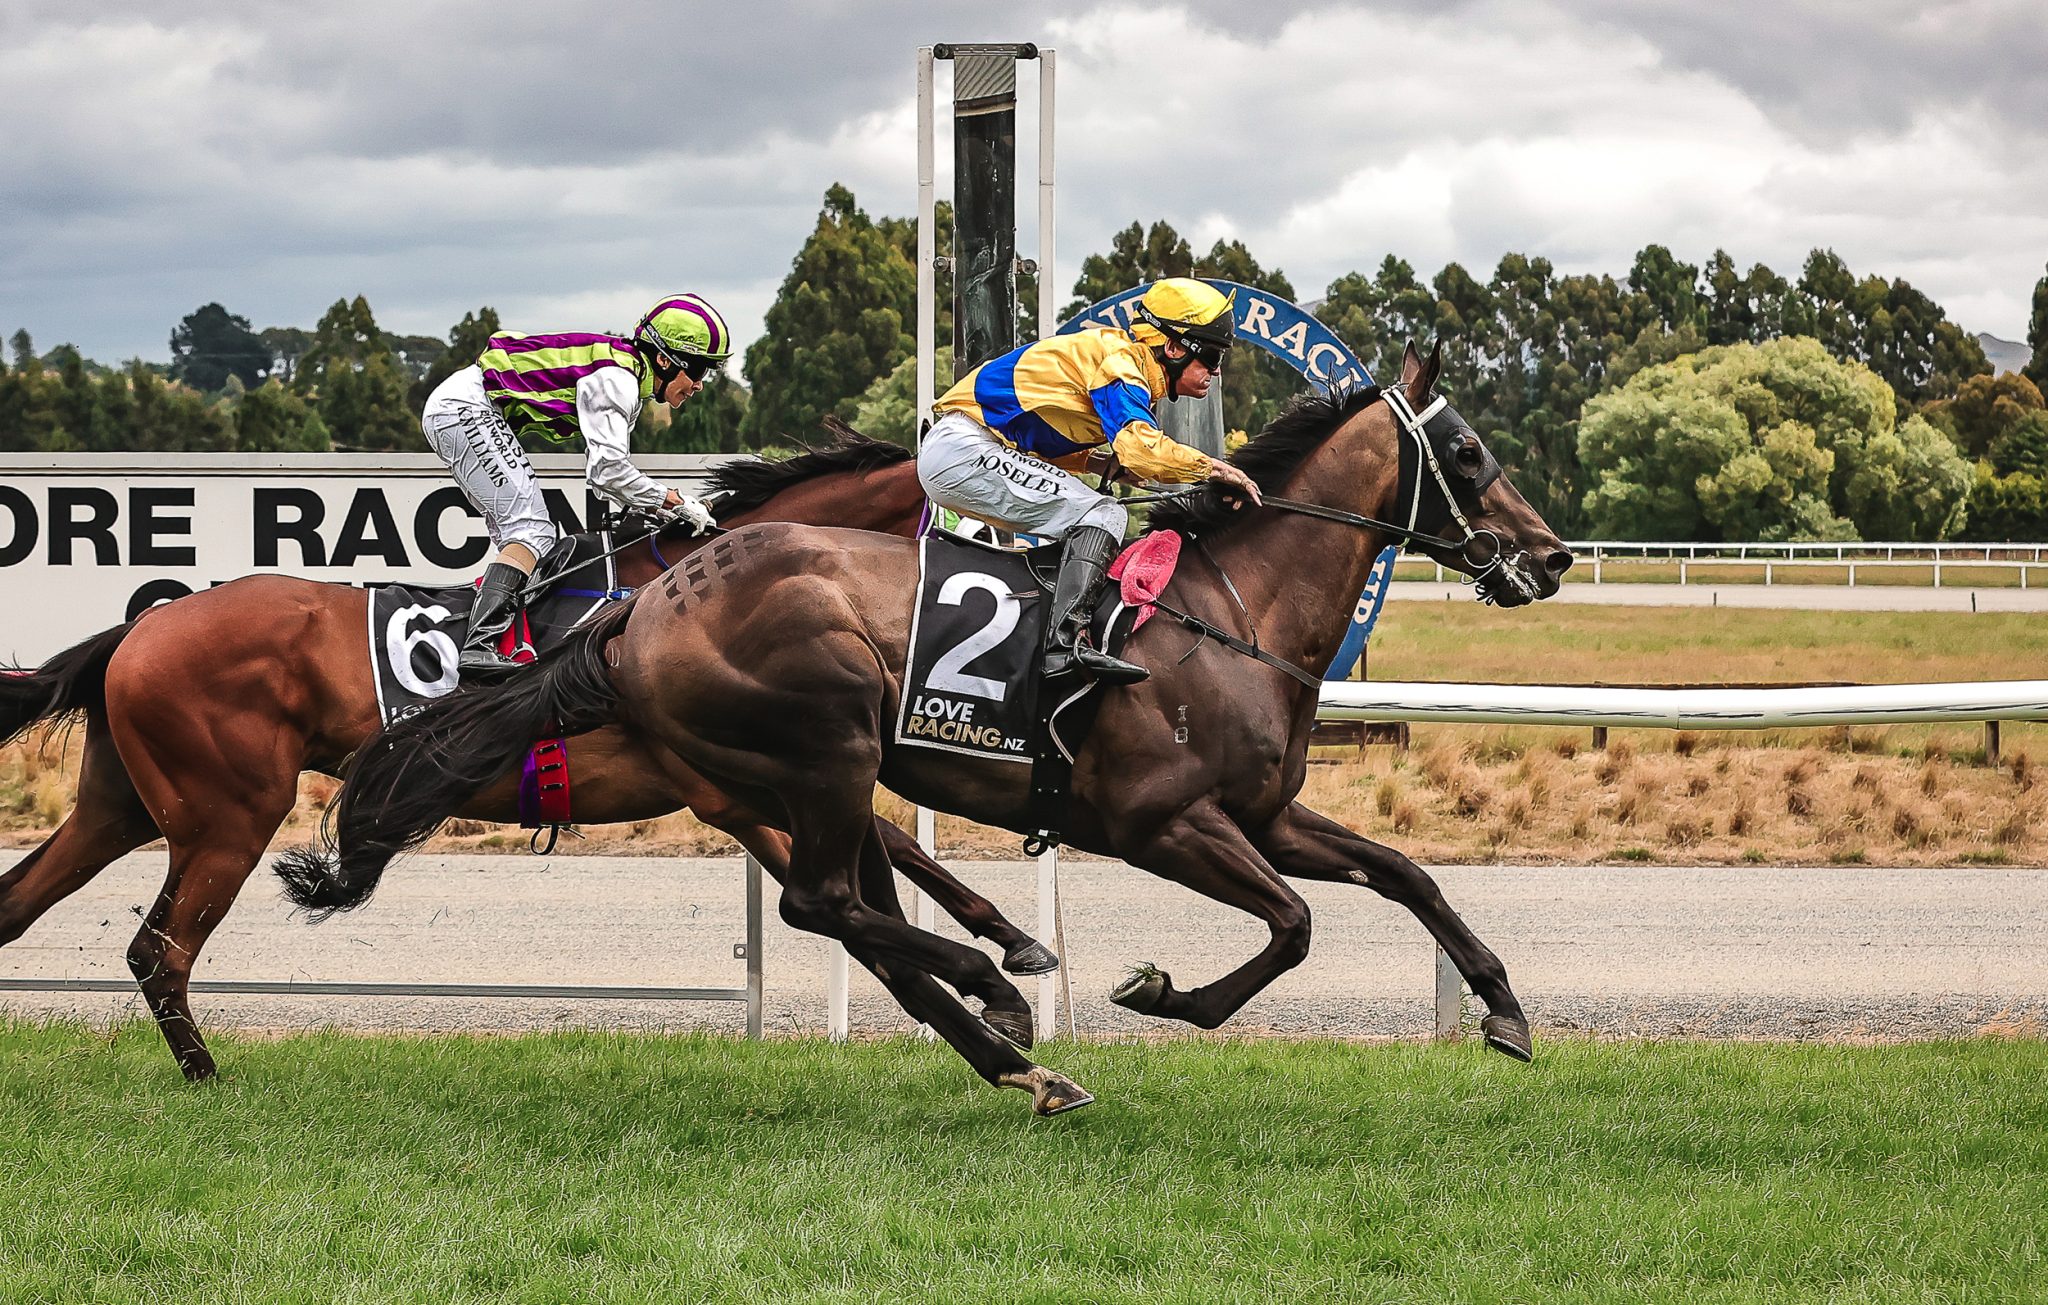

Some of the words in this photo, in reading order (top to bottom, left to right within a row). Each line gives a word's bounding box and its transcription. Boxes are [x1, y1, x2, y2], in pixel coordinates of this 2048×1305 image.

[386, 603, 461, 699] 6
[924, 571, 1021, 702] 2
[906, 715, 1027, 752] RACING.NZ
[912, 695, 976, 723] LOVE
